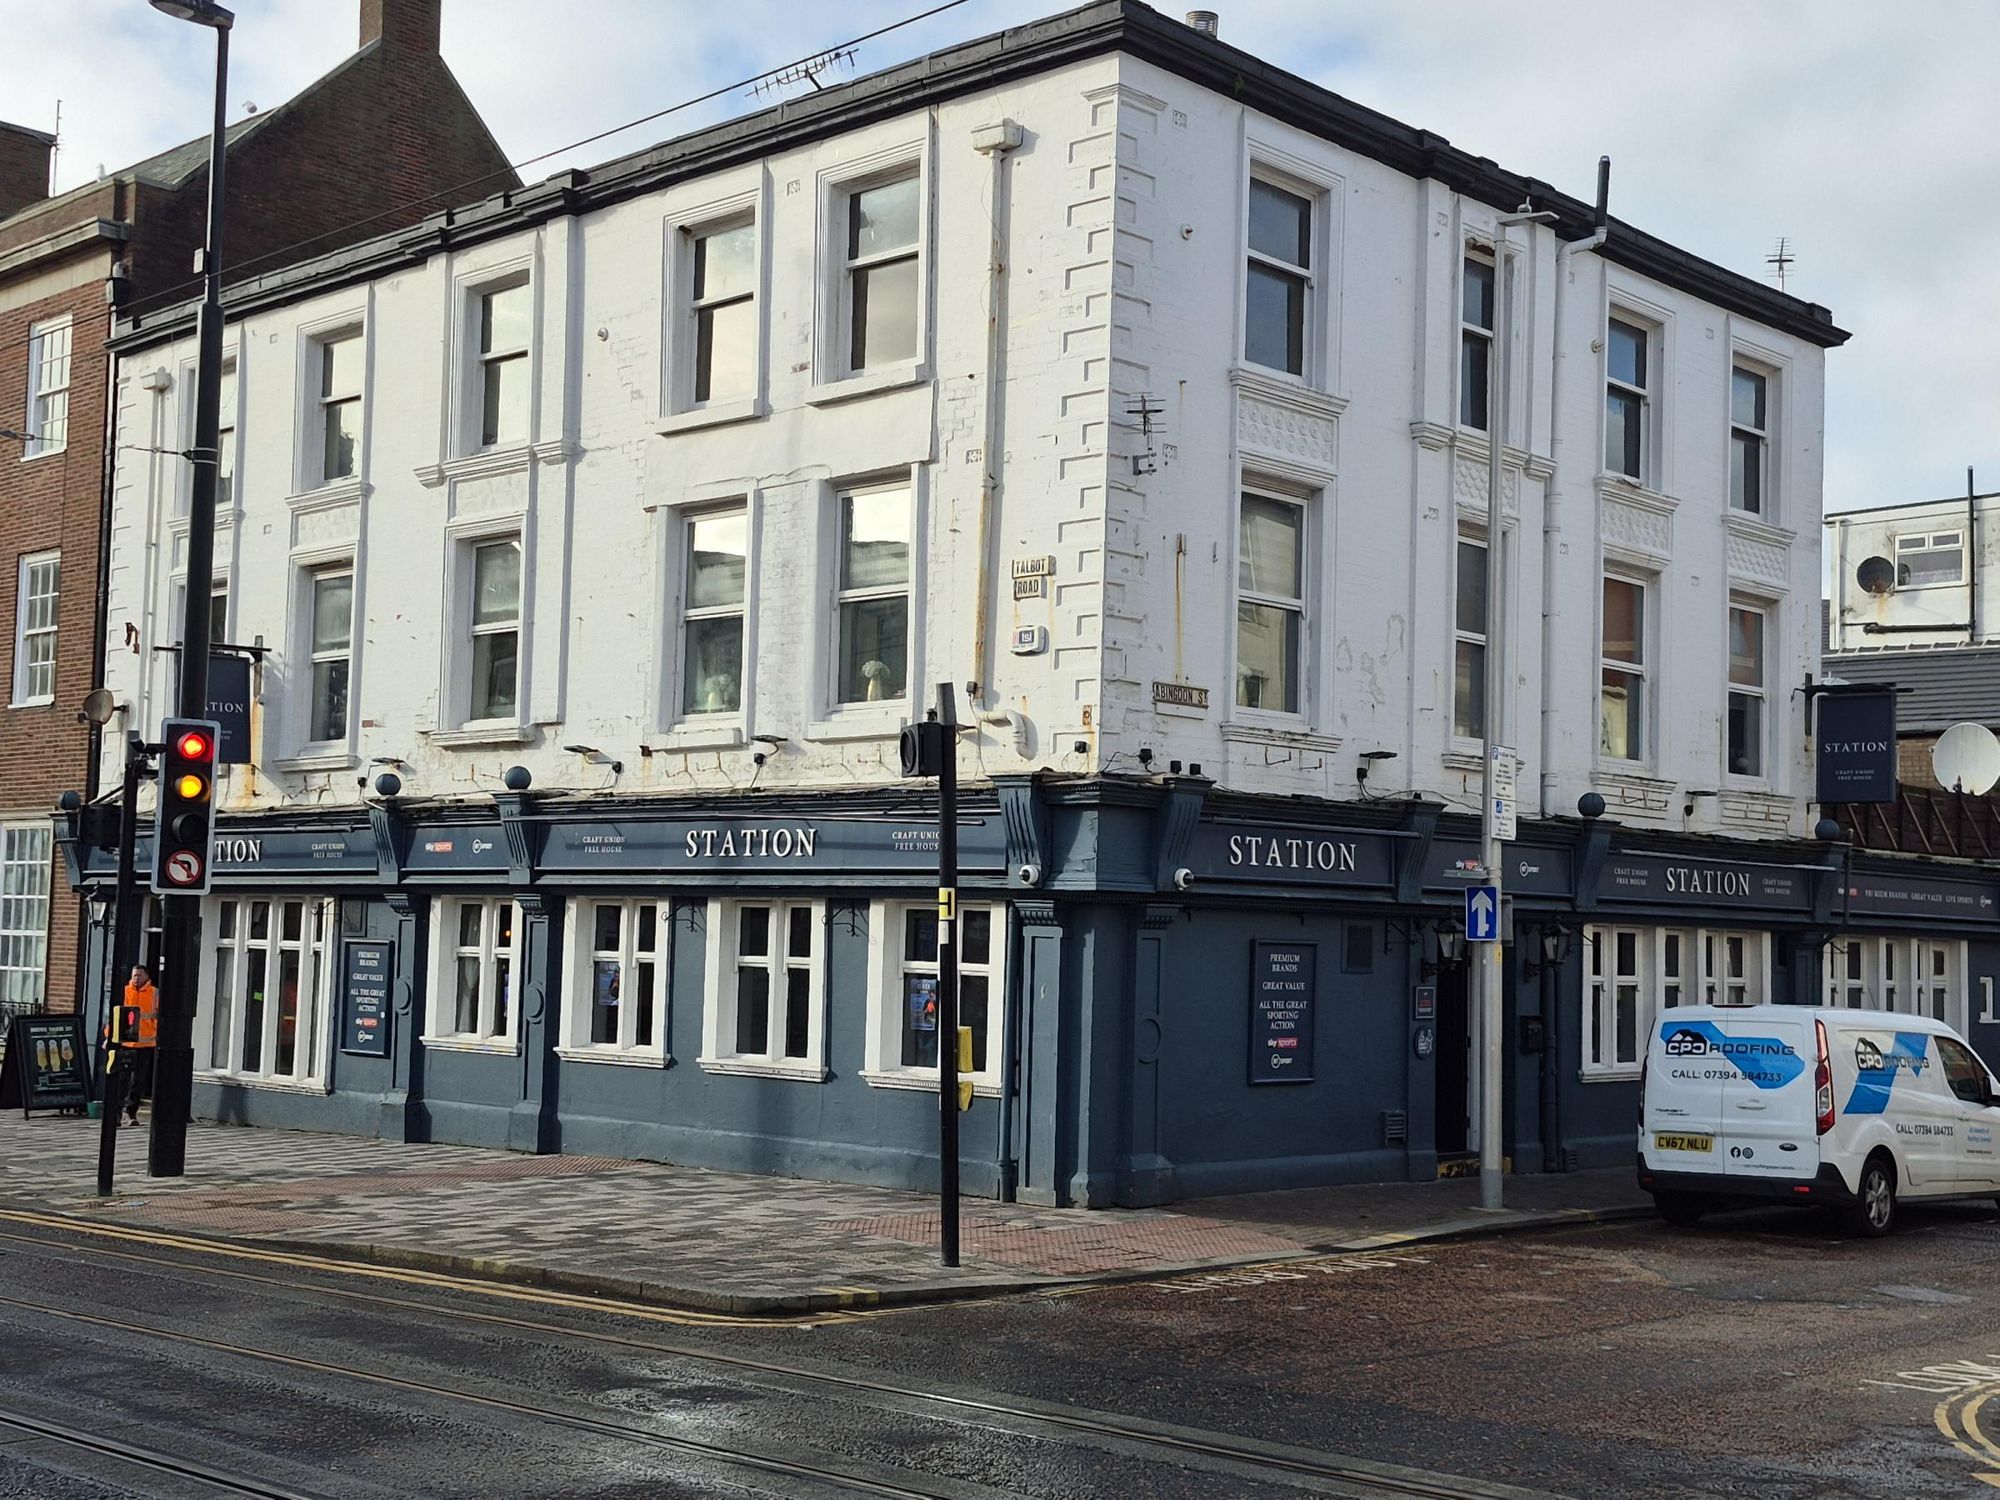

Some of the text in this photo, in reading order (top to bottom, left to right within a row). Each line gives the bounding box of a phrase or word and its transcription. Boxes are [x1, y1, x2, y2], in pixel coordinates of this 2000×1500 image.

[1016, 559, 1046, 574] TALBOT
[1017, 579, 1039, 594] ROAD
[1155, 684, 1193, 704] ABINGDON
[1825, 742, 1888, 753] STATION
[892, 831, 918, 840] CRAFT
[685, 828, 817, 857] STATION
[894, 842, 940, 851] FREE HOUS
[584, 845, 623, 853] FREE HOUSE
[1229, 834, 1357, 872] STATION
[1614, 867, 1630, 875] CRAFT
[1666, 867, 1750, 897] STATION
[1270, 953, 1300, 963] PREMIUM
[1272, 963, 1298, 972] BRANDS
[1262, 981, 1305, 990] GREAT VALUE
[1259, 1000, 1308, 1009] ALL THE GREAT
[1267, 1010, 1299, 1020] SPORTING
[1270, 1021, 1295, 1030] ACTION
[1709, 1043, 1796, 1056] ROOFING
[1884, 1055, 1930, 1069] ROOFING
[1671, 1069, 1782, 1082] CALL: 07394 584733
[1895, 1123, 1953, 1136] CALL: 07394 584733
[1687, 1138, 1708, 1150] NLU
